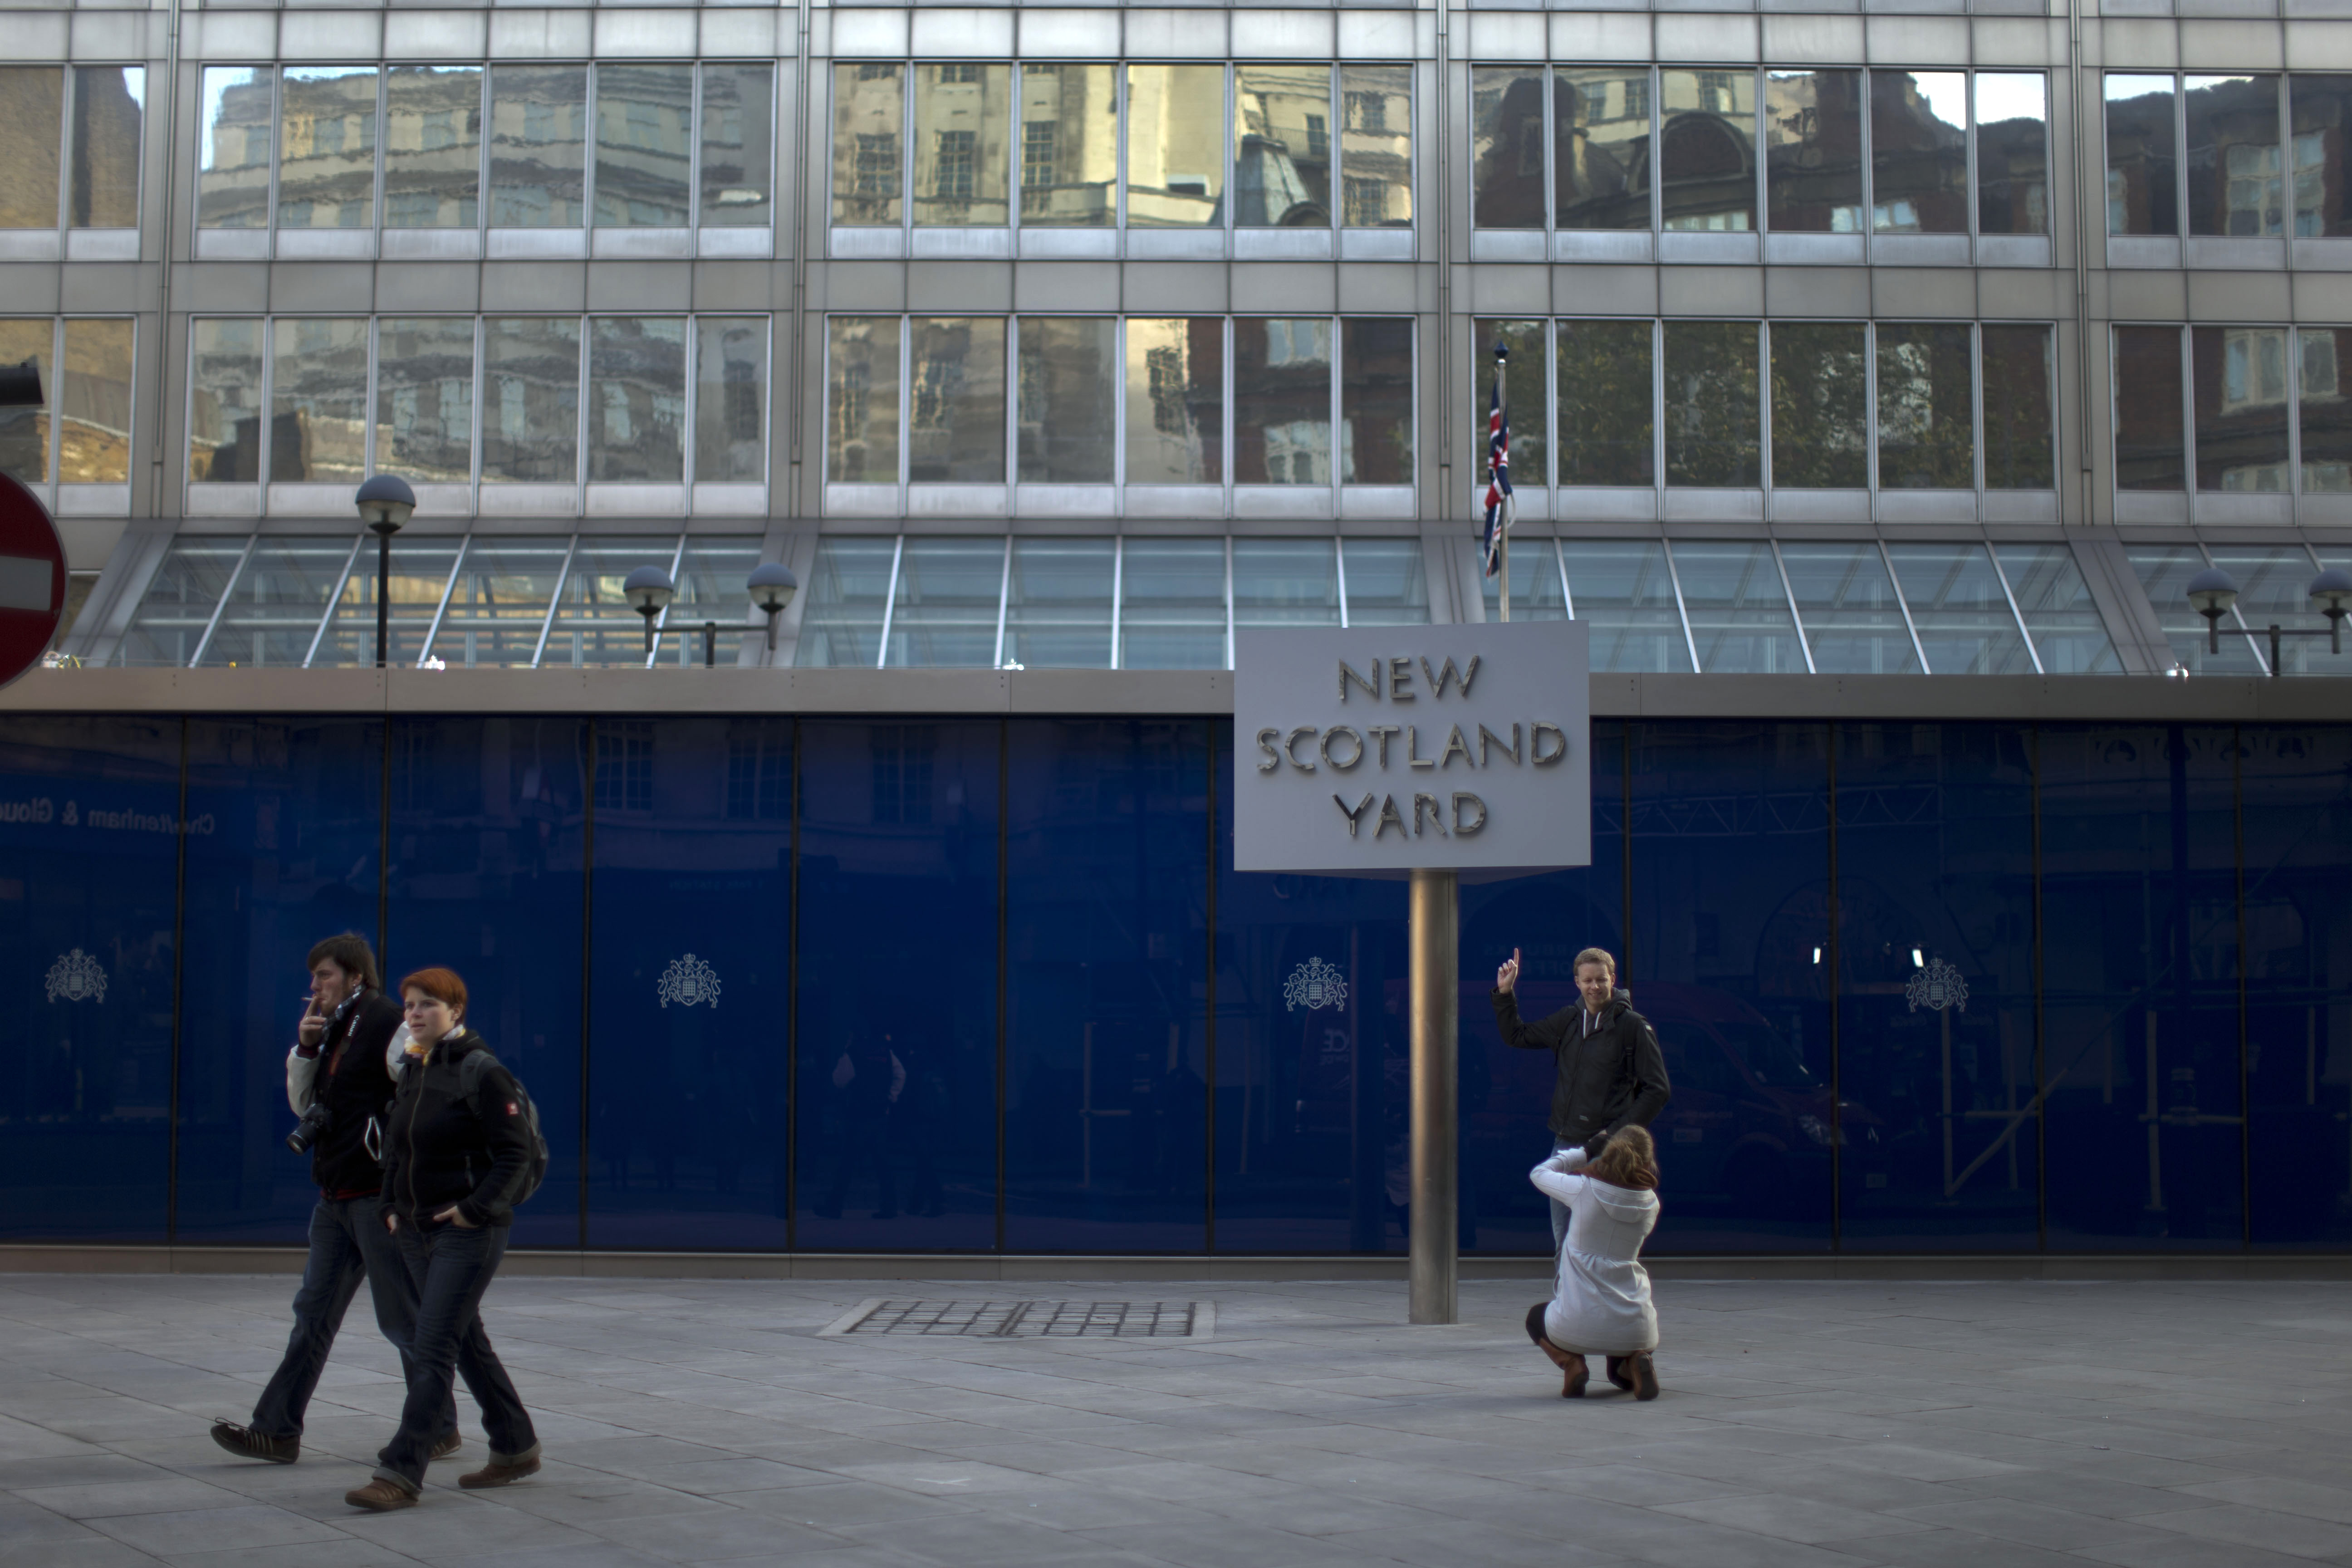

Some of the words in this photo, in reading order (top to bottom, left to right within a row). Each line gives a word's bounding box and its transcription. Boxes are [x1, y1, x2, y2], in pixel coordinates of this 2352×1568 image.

[1339, 654, 1480, 701] NEW
[1256, 722, 1565, 770] SCOTLAND
[1333, 791, 1486, 838] YARD
